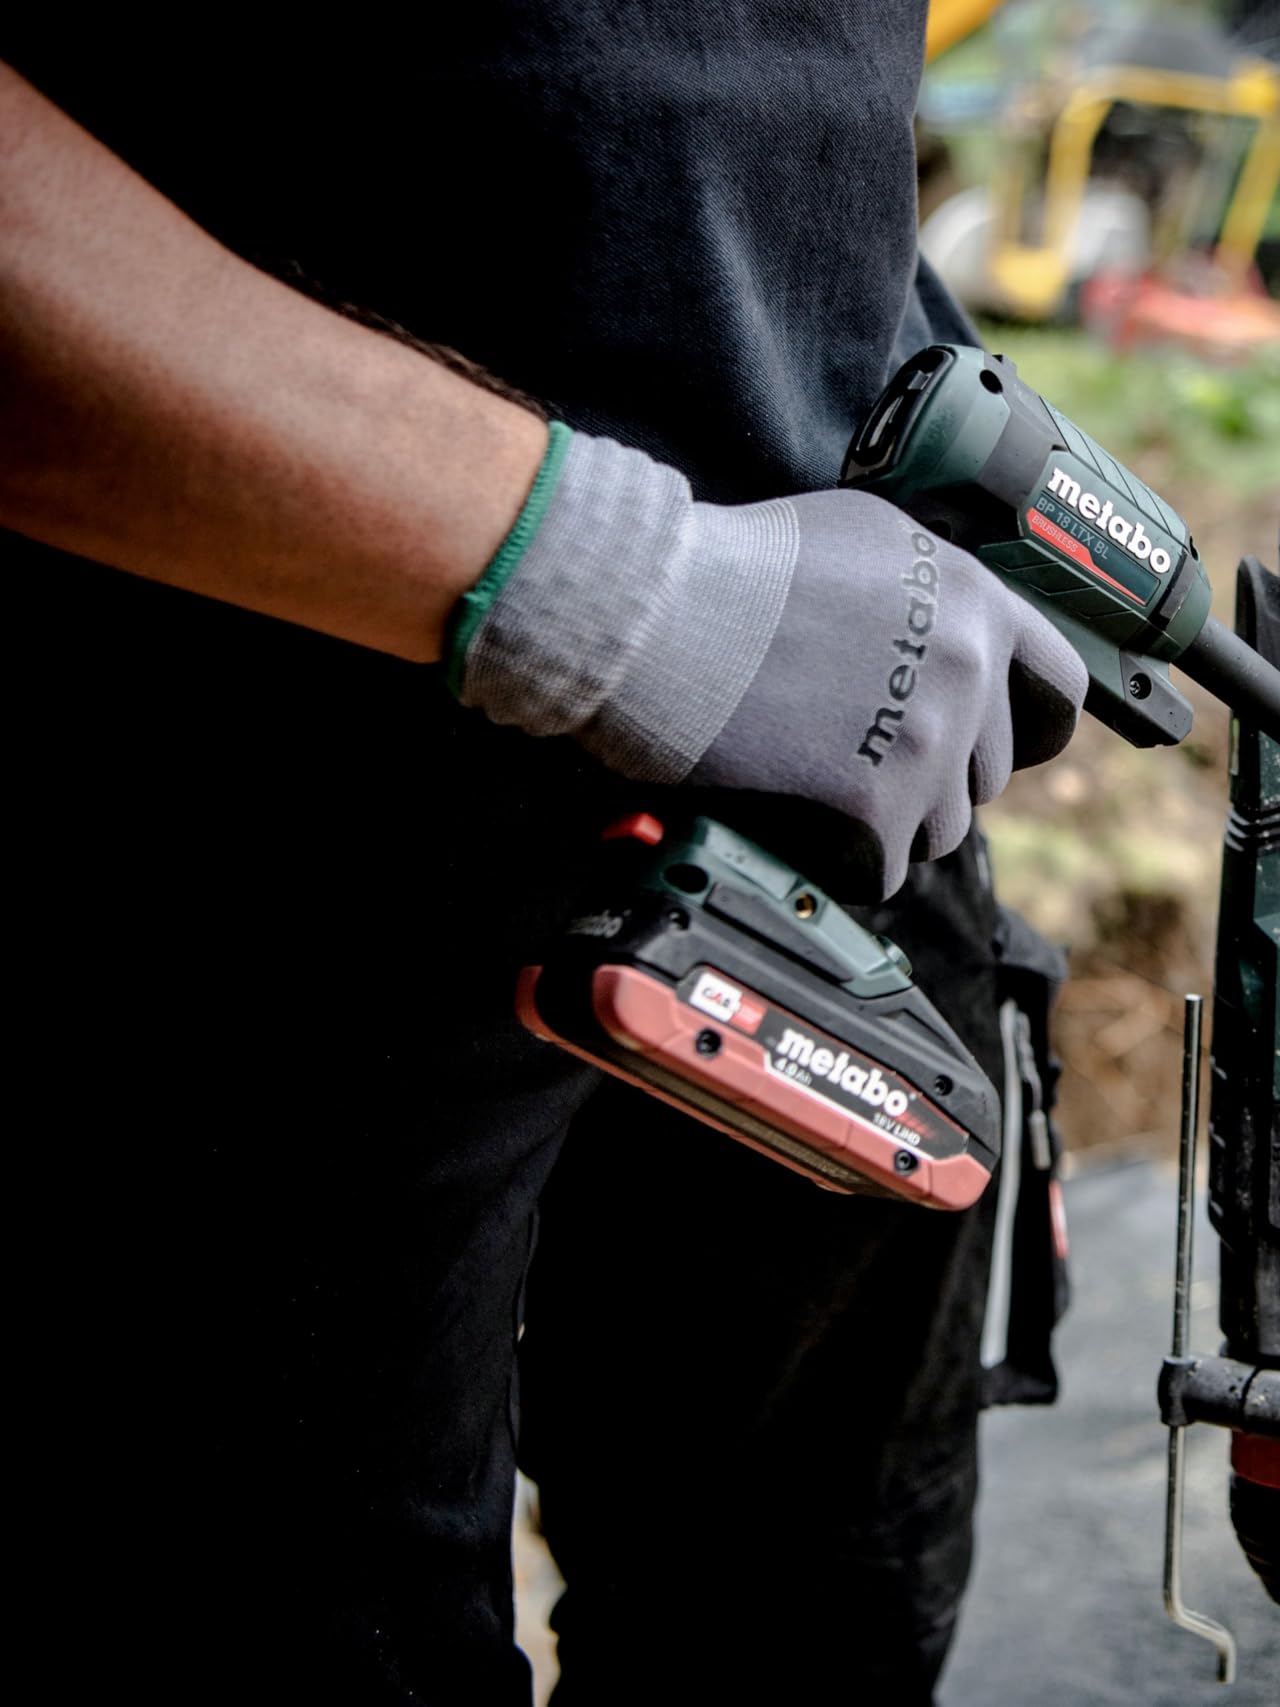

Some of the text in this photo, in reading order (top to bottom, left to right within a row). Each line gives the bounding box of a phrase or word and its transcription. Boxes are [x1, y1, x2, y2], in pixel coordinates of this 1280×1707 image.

[1032, 514, 1078, 552] BRUSHLESS
[1035, 498, 1109, 560] BP 18 LTX BL
[1047, 467, 1171, 573] metabo
[857, 531, 938, 767] metabo
[776, 1028, 908, 1116] metabo
